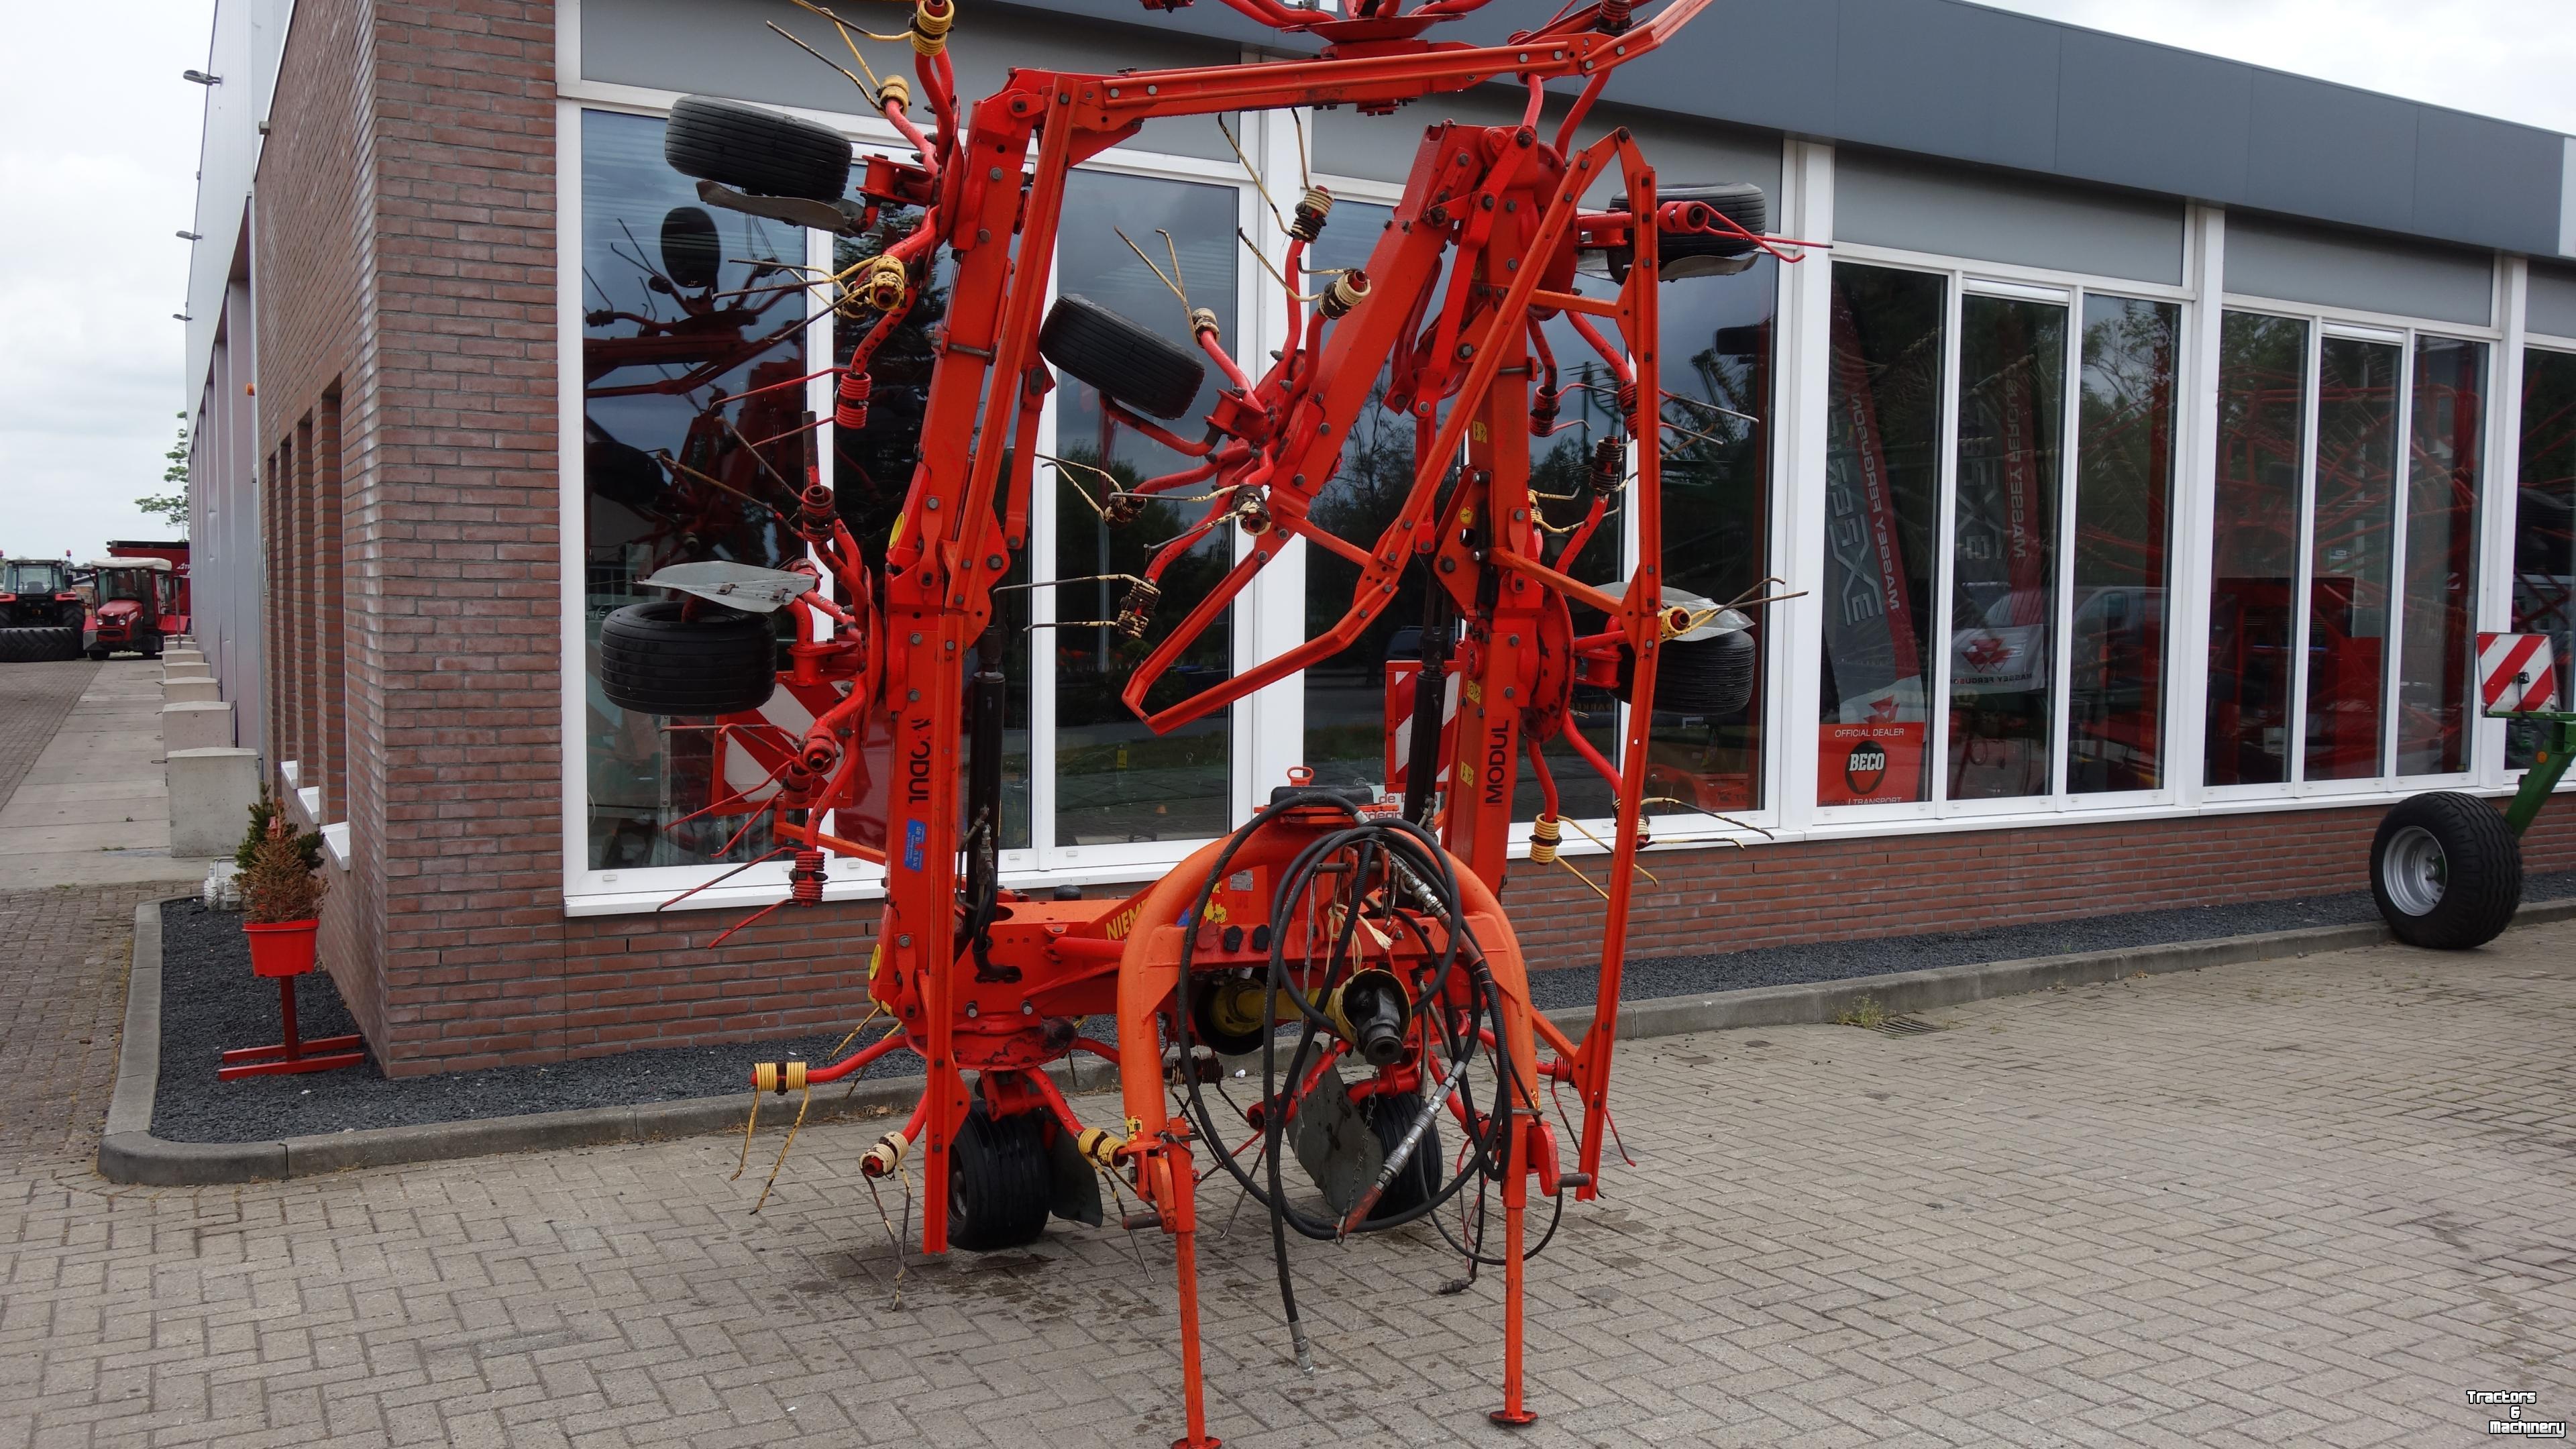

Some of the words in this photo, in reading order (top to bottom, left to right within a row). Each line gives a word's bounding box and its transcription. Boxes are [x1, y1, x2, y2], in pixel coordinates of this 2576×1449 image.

[1835, 729, 1871, 738] OFFICIAL
[1872, 728, 1904, 737] DEALER
[1485, 719, 1510, 804] MODUL
[1849, 753, 1885, 771] BECO
[1105, 898, 1148, 941] NIEM
